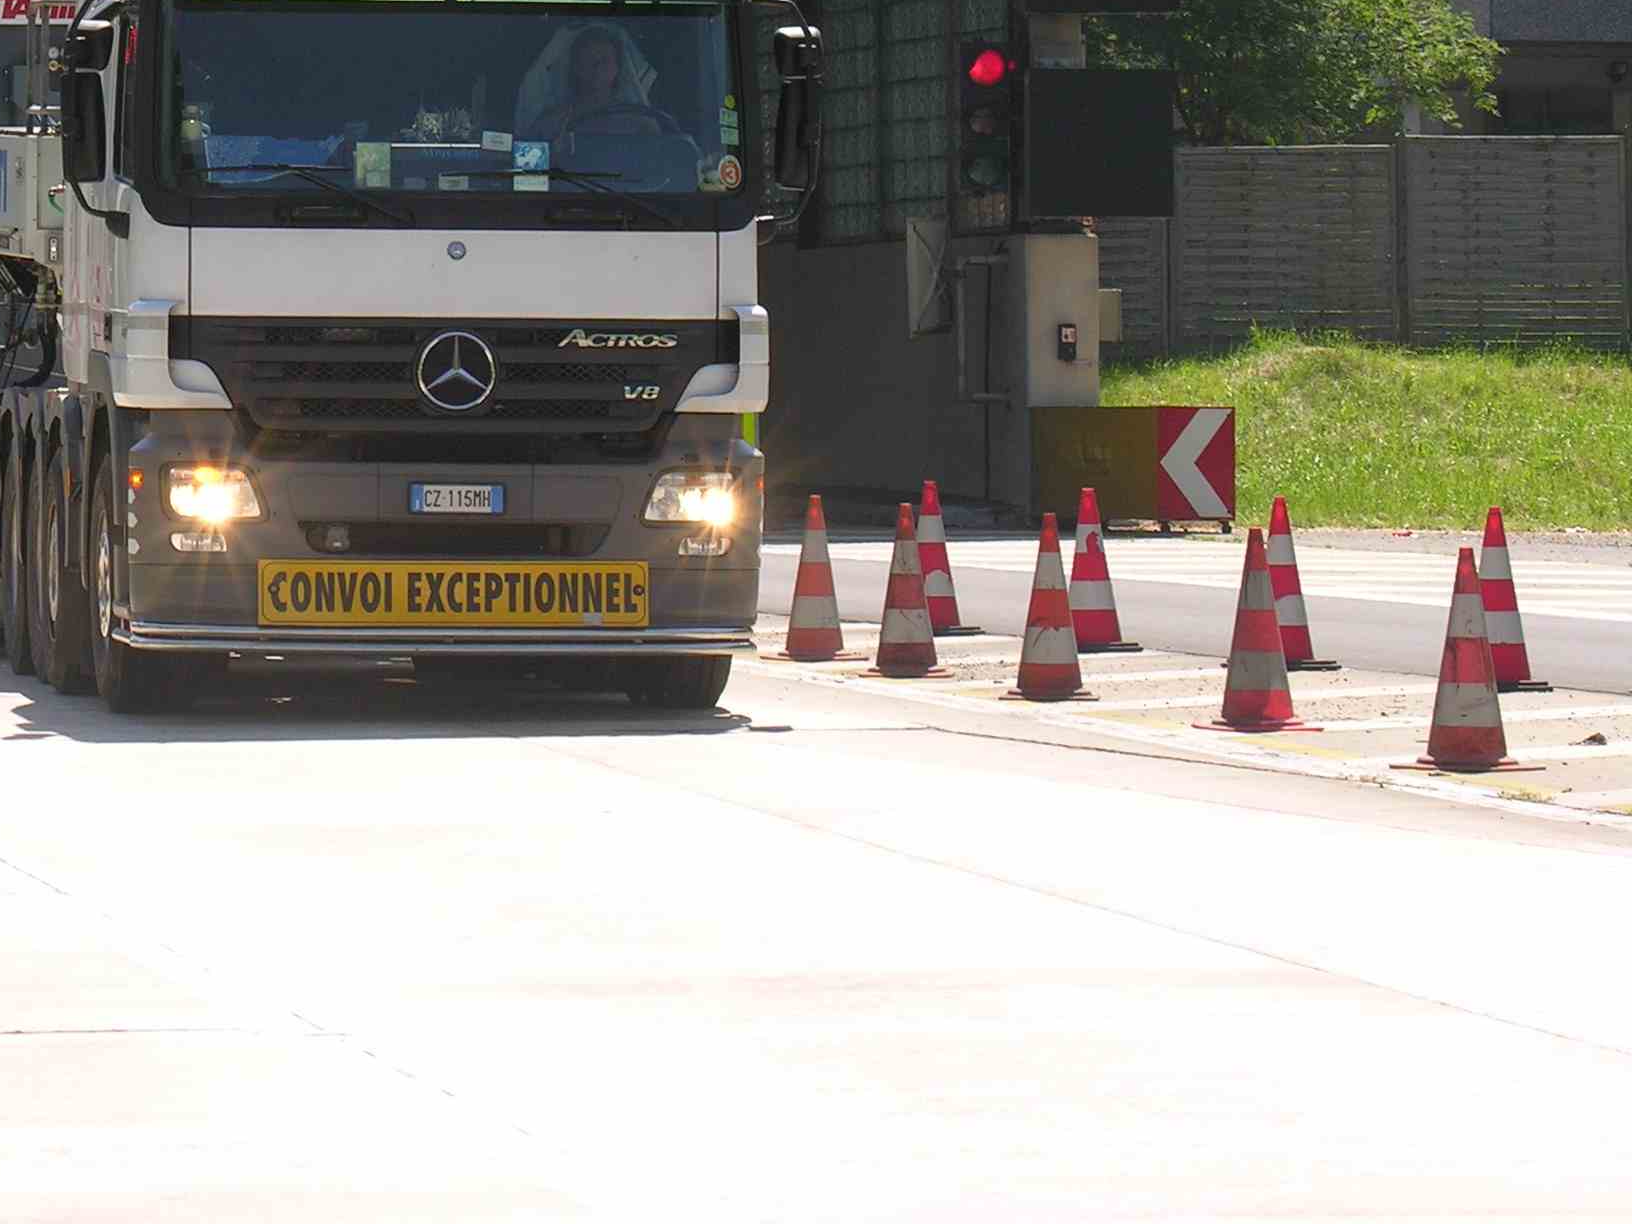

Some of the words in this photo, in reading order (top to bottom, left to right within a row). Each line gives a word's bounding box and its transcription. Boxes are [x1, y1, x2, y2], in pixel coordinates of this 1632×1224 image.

[557, 328, 679, 348] ACTROS
[623, 385, 661, 400] V8
[270, 570, 394, 614] CONVOI
[407, 571, 639, 614] EXCEPTIONNEL
